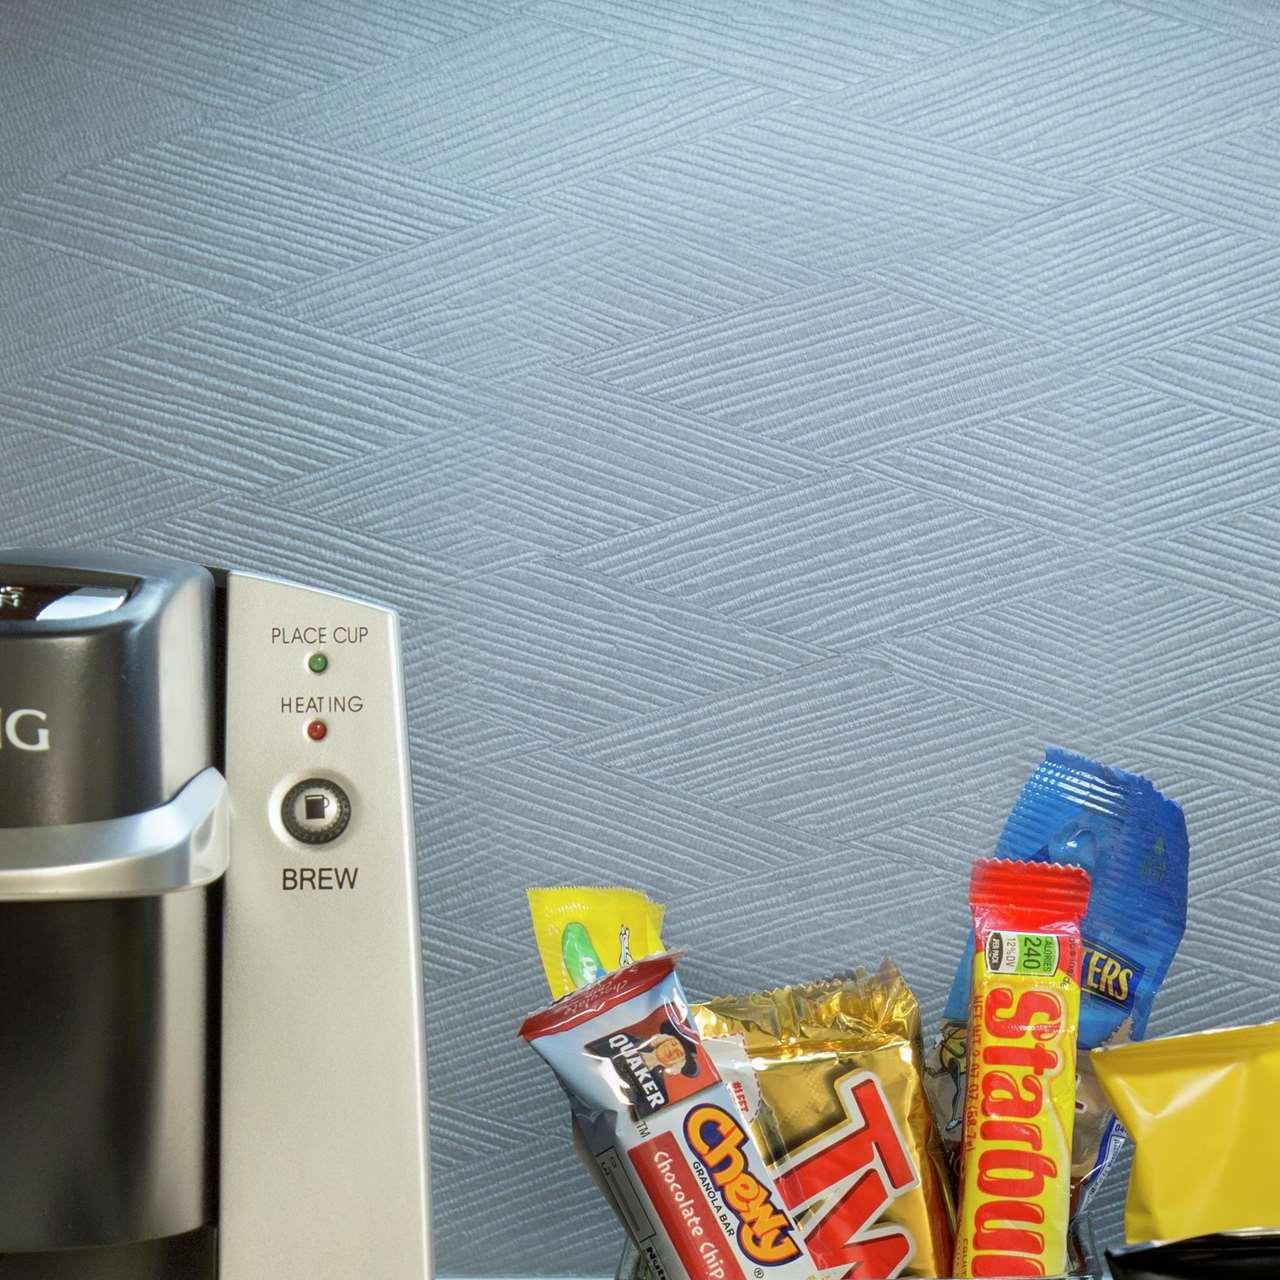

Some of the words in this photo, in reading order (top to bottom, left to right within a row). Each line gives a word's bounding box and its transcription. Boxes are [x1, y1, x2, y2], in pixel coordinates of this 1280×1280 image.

[272, 627, 327, 643] PLACE
[333, 627, 368, 643] CUP
[282, 696, 363, 713] HEATING
[283, 868, 358, 890] BREW
[1023, 937, 1041, 970] 240
[609, 1034, 665, 1108] QUAKER
[684, 1104, 803, 1266] Chewy
[693, 1161, 722, 1215] GRANOLA
[719, 1214, 735, 1237] BAR
[654, 1151, 704, 1237] Chocolate
[699, 1242, 726, 1280] Chip
